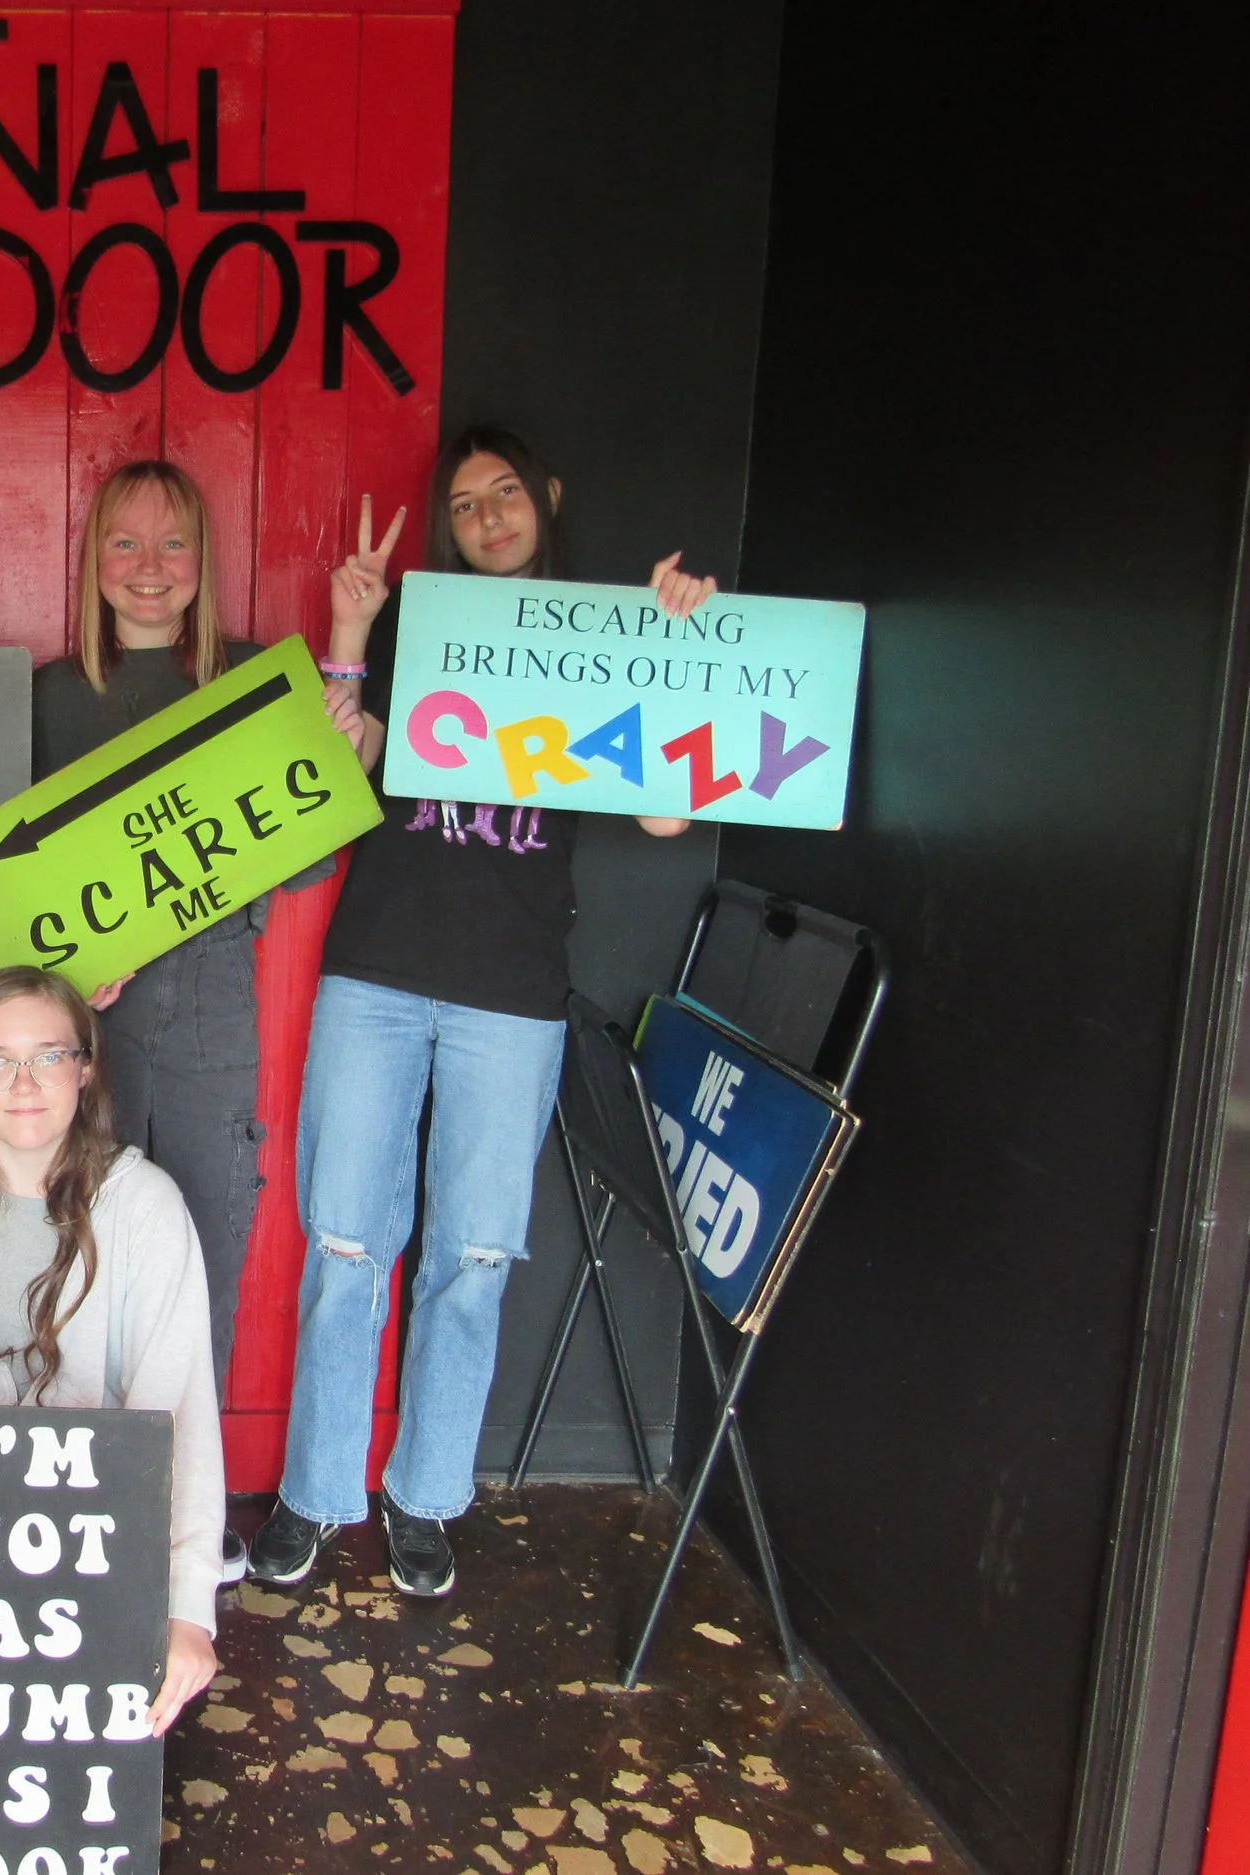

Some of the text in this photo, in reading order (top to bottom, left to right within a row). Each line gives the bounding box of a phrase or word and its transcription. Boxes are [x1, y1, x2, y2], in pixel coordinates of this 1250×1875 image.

[514, 597, 746, 645] ESCAPING
[440, 642, 811, 700] BRINGS OUT MY
[406, 689, 831, 813] CRAZY
[123, 783, 199, 849] SHE
[29, 759, 331, 970] SCARES
[169, 876, 232, 932] ME
[691, 1050, 745, 1137] WE
[651, 1102, 759, 1279] IED
[81, 1765, 117, 1823] I
